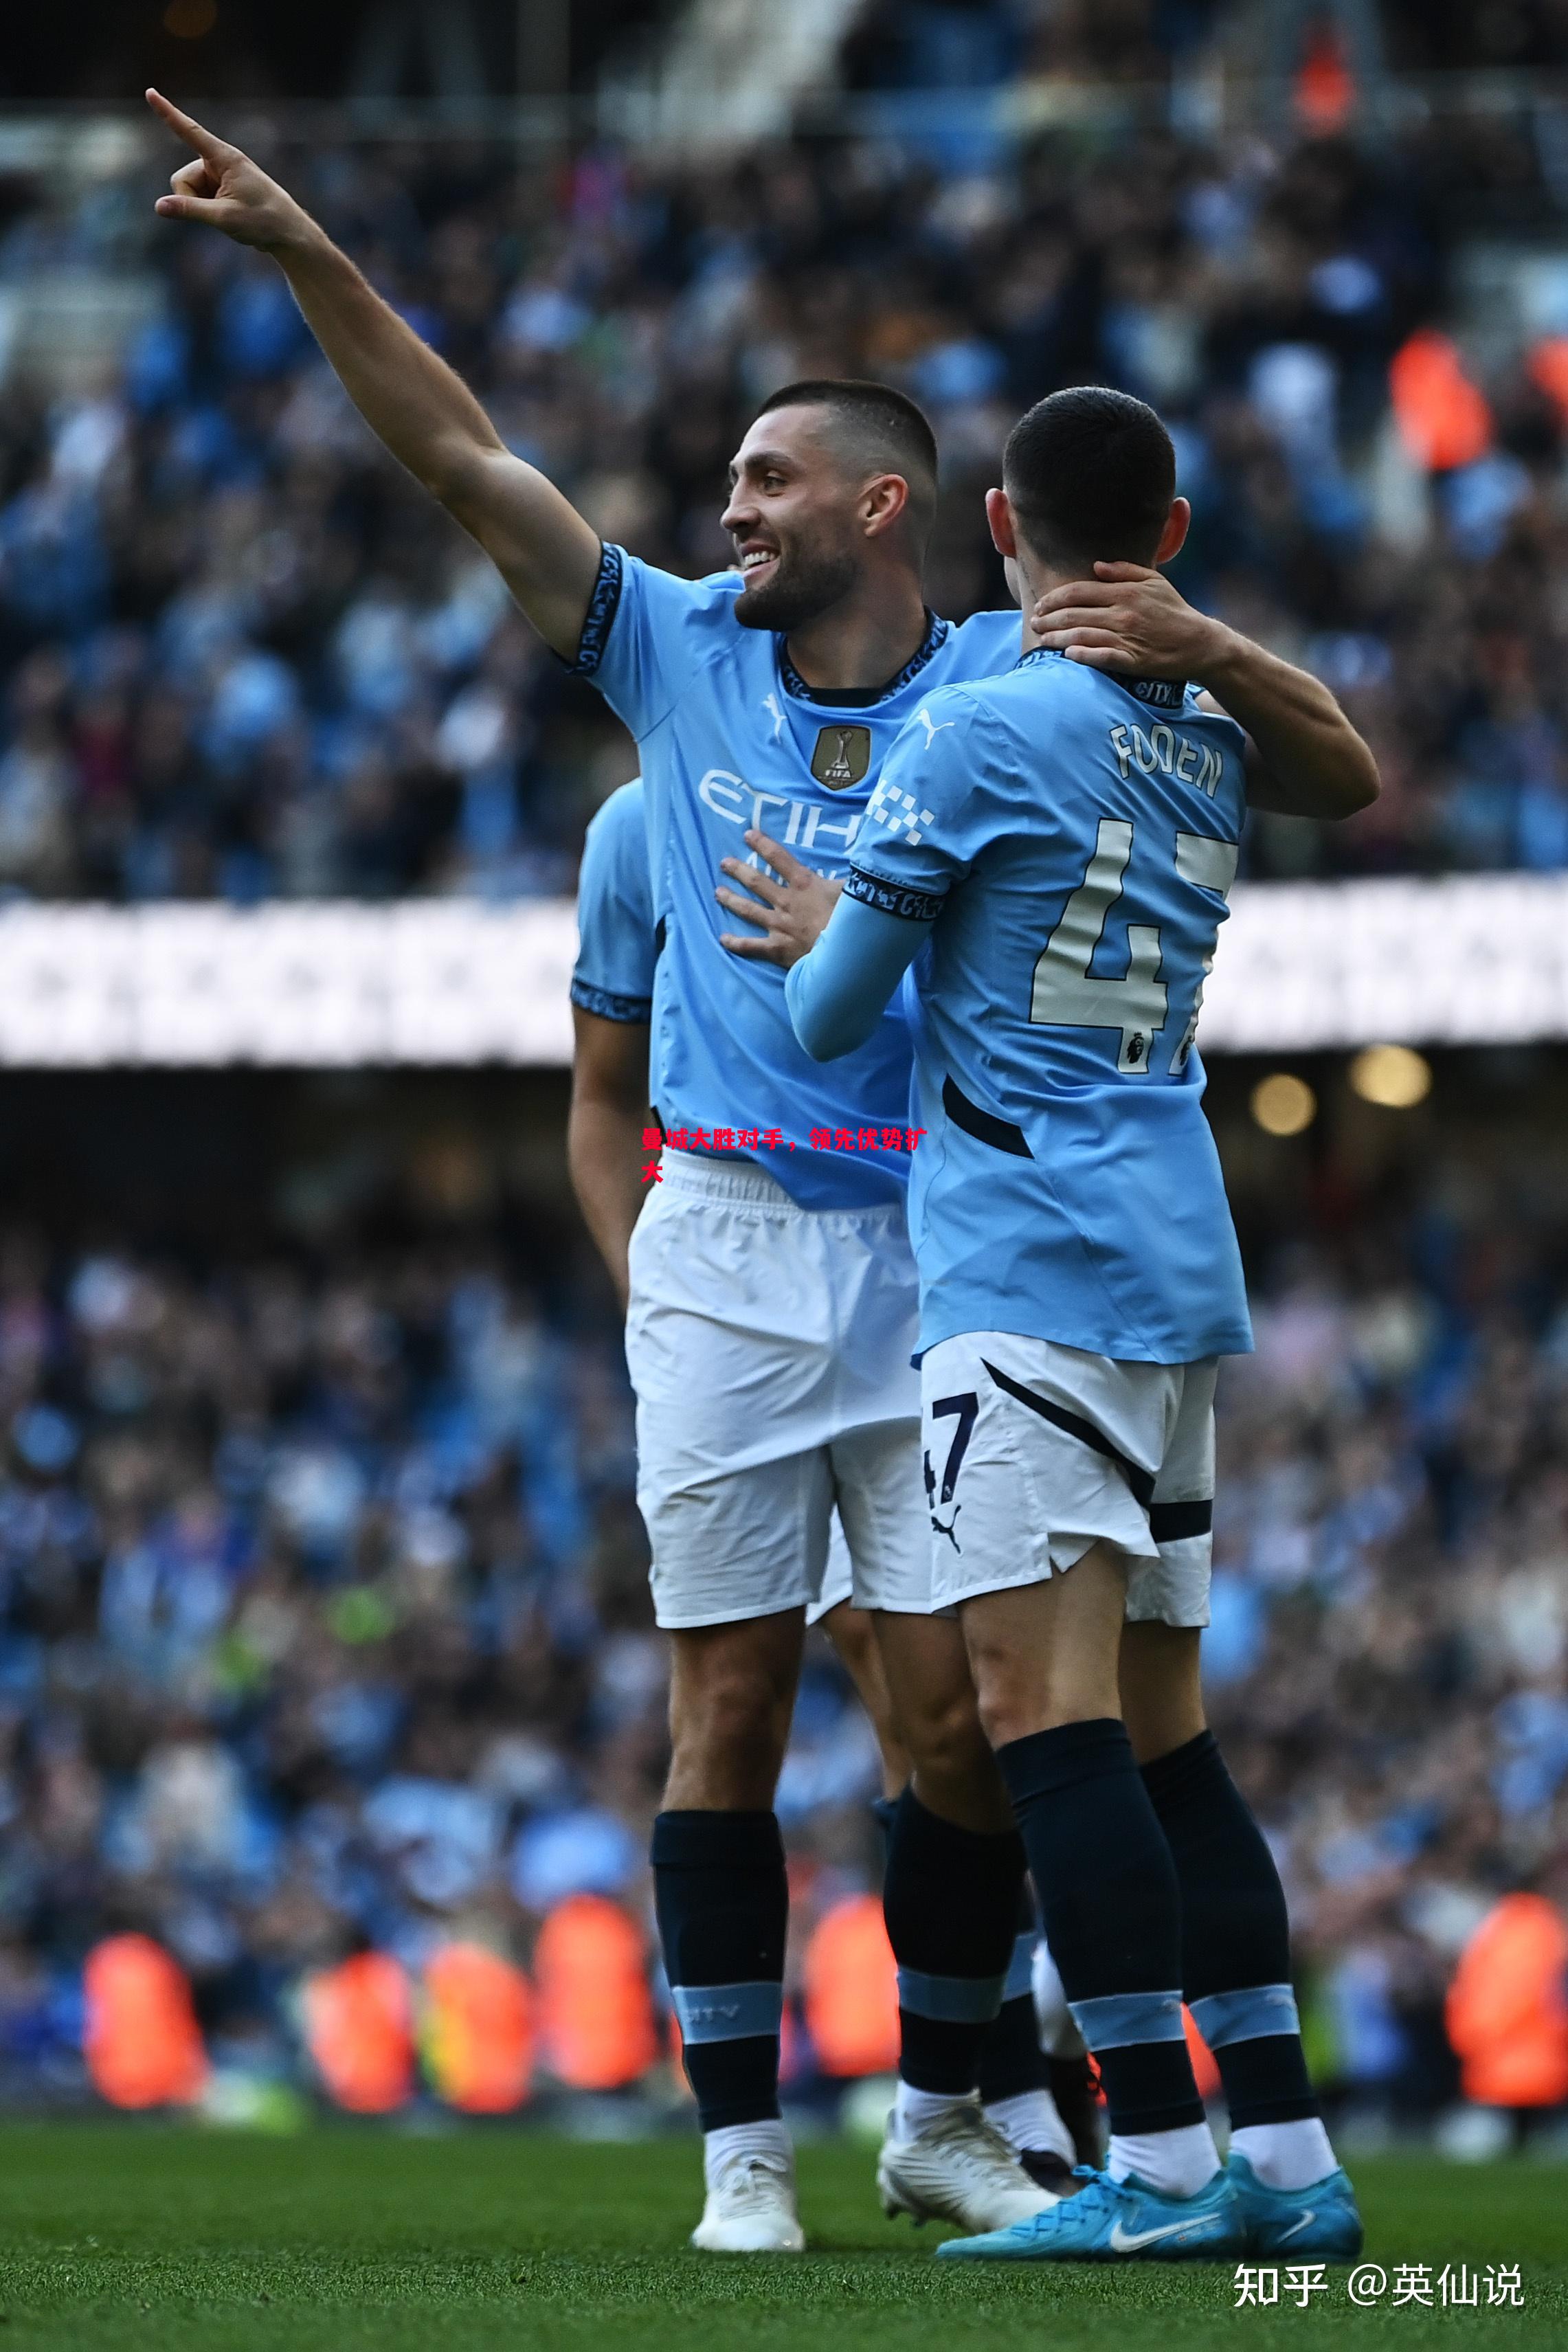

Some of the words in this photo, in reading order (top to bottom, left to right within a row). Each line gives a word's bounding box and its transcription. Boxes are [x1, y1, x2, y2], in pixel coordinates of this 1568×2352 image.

[825, 770, 851, 778] FIFA
[1110, 724, 1222, 799] FODEN
[698, 769, 862, 849] ETIH
